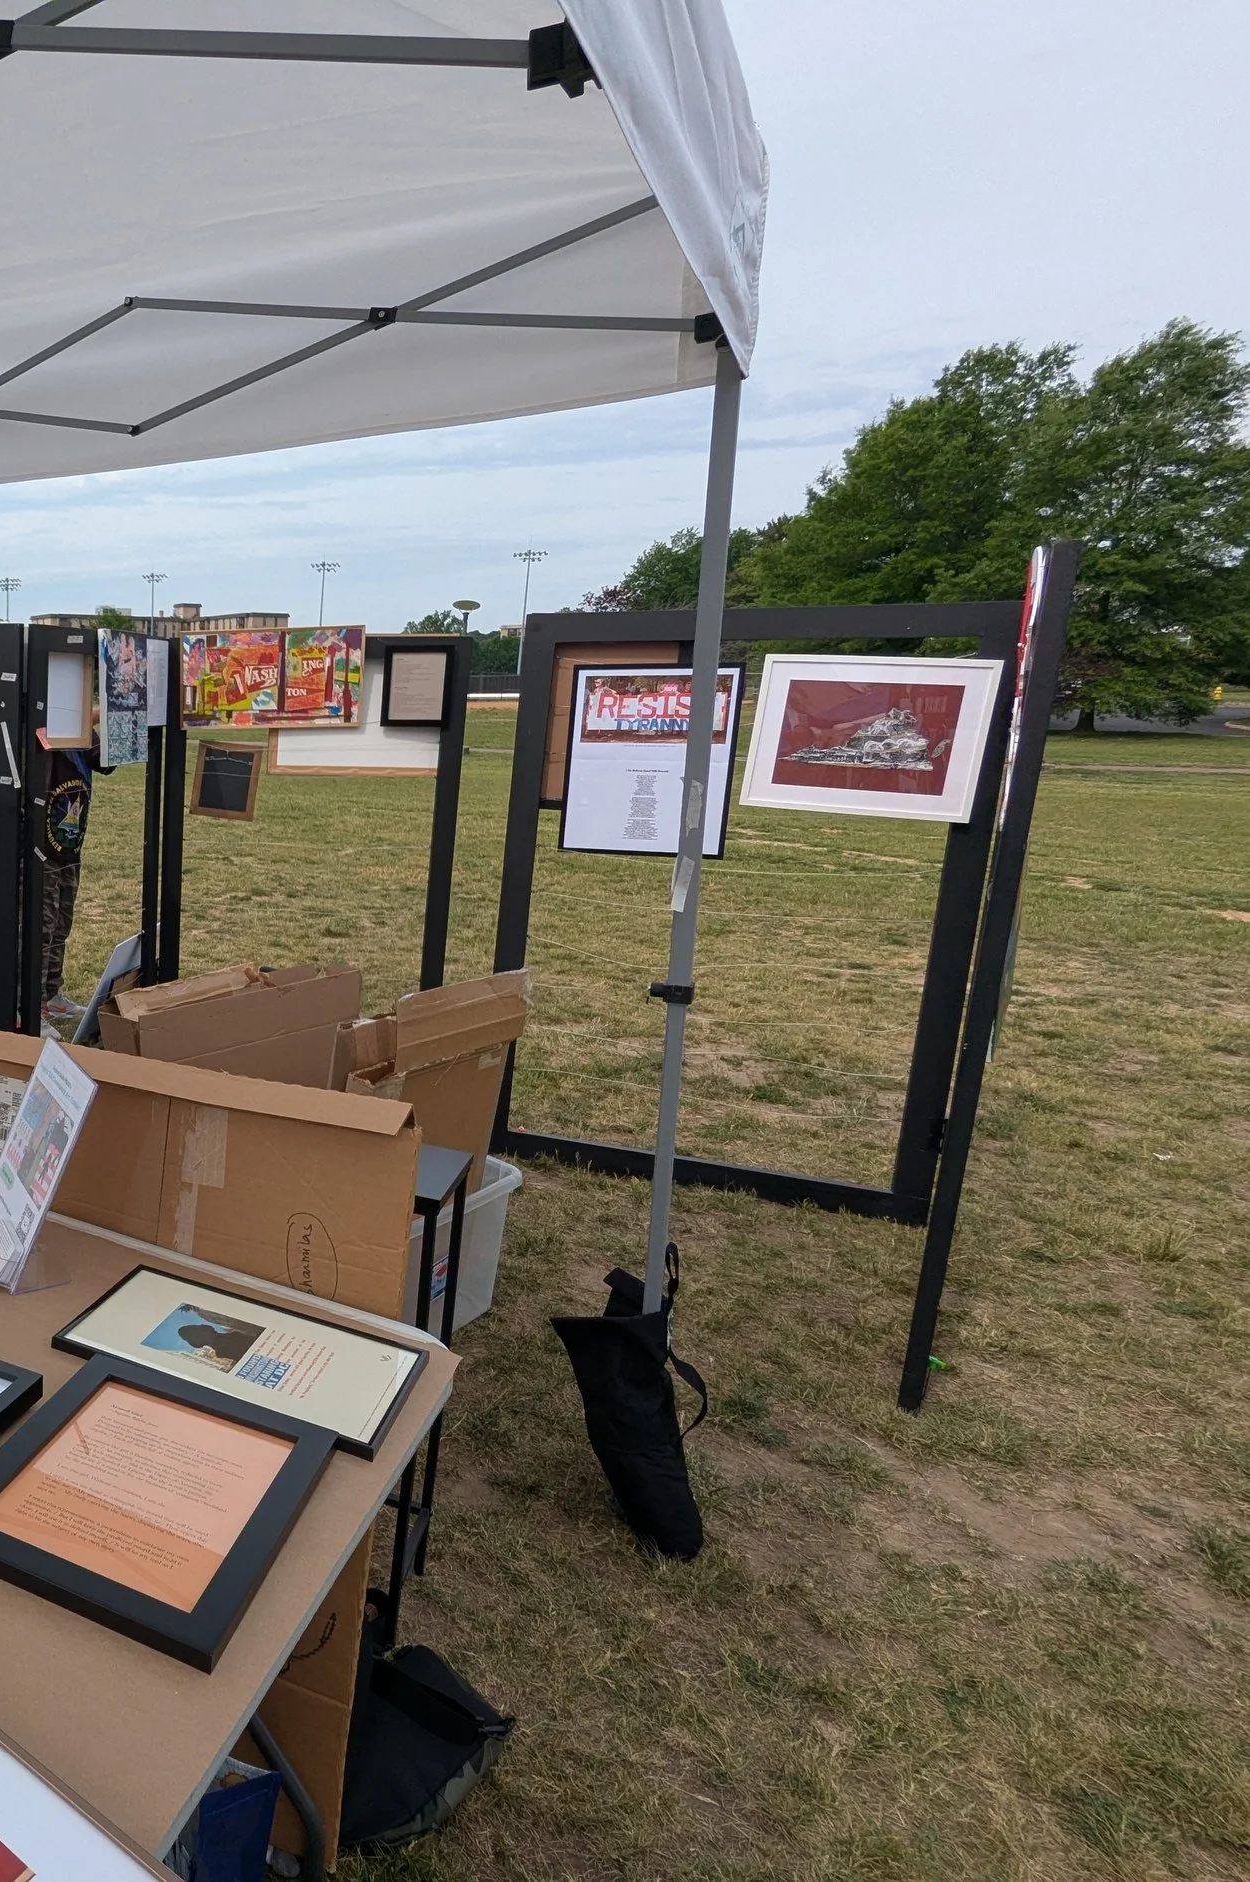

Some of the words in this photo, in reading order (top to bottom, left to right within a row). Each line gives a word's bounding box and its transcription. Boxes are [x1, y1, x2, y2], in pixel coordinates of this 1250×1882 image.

[286, 687, 307, 697] TON
[597, 692, 691, 718] RESIS
[238, 1353, 261, 1376] FOUND
[253, 1358, 280, 1385] STARING
[263, 1374, 280, 1388] AT
[273, 1361, 289, 1376] DC
